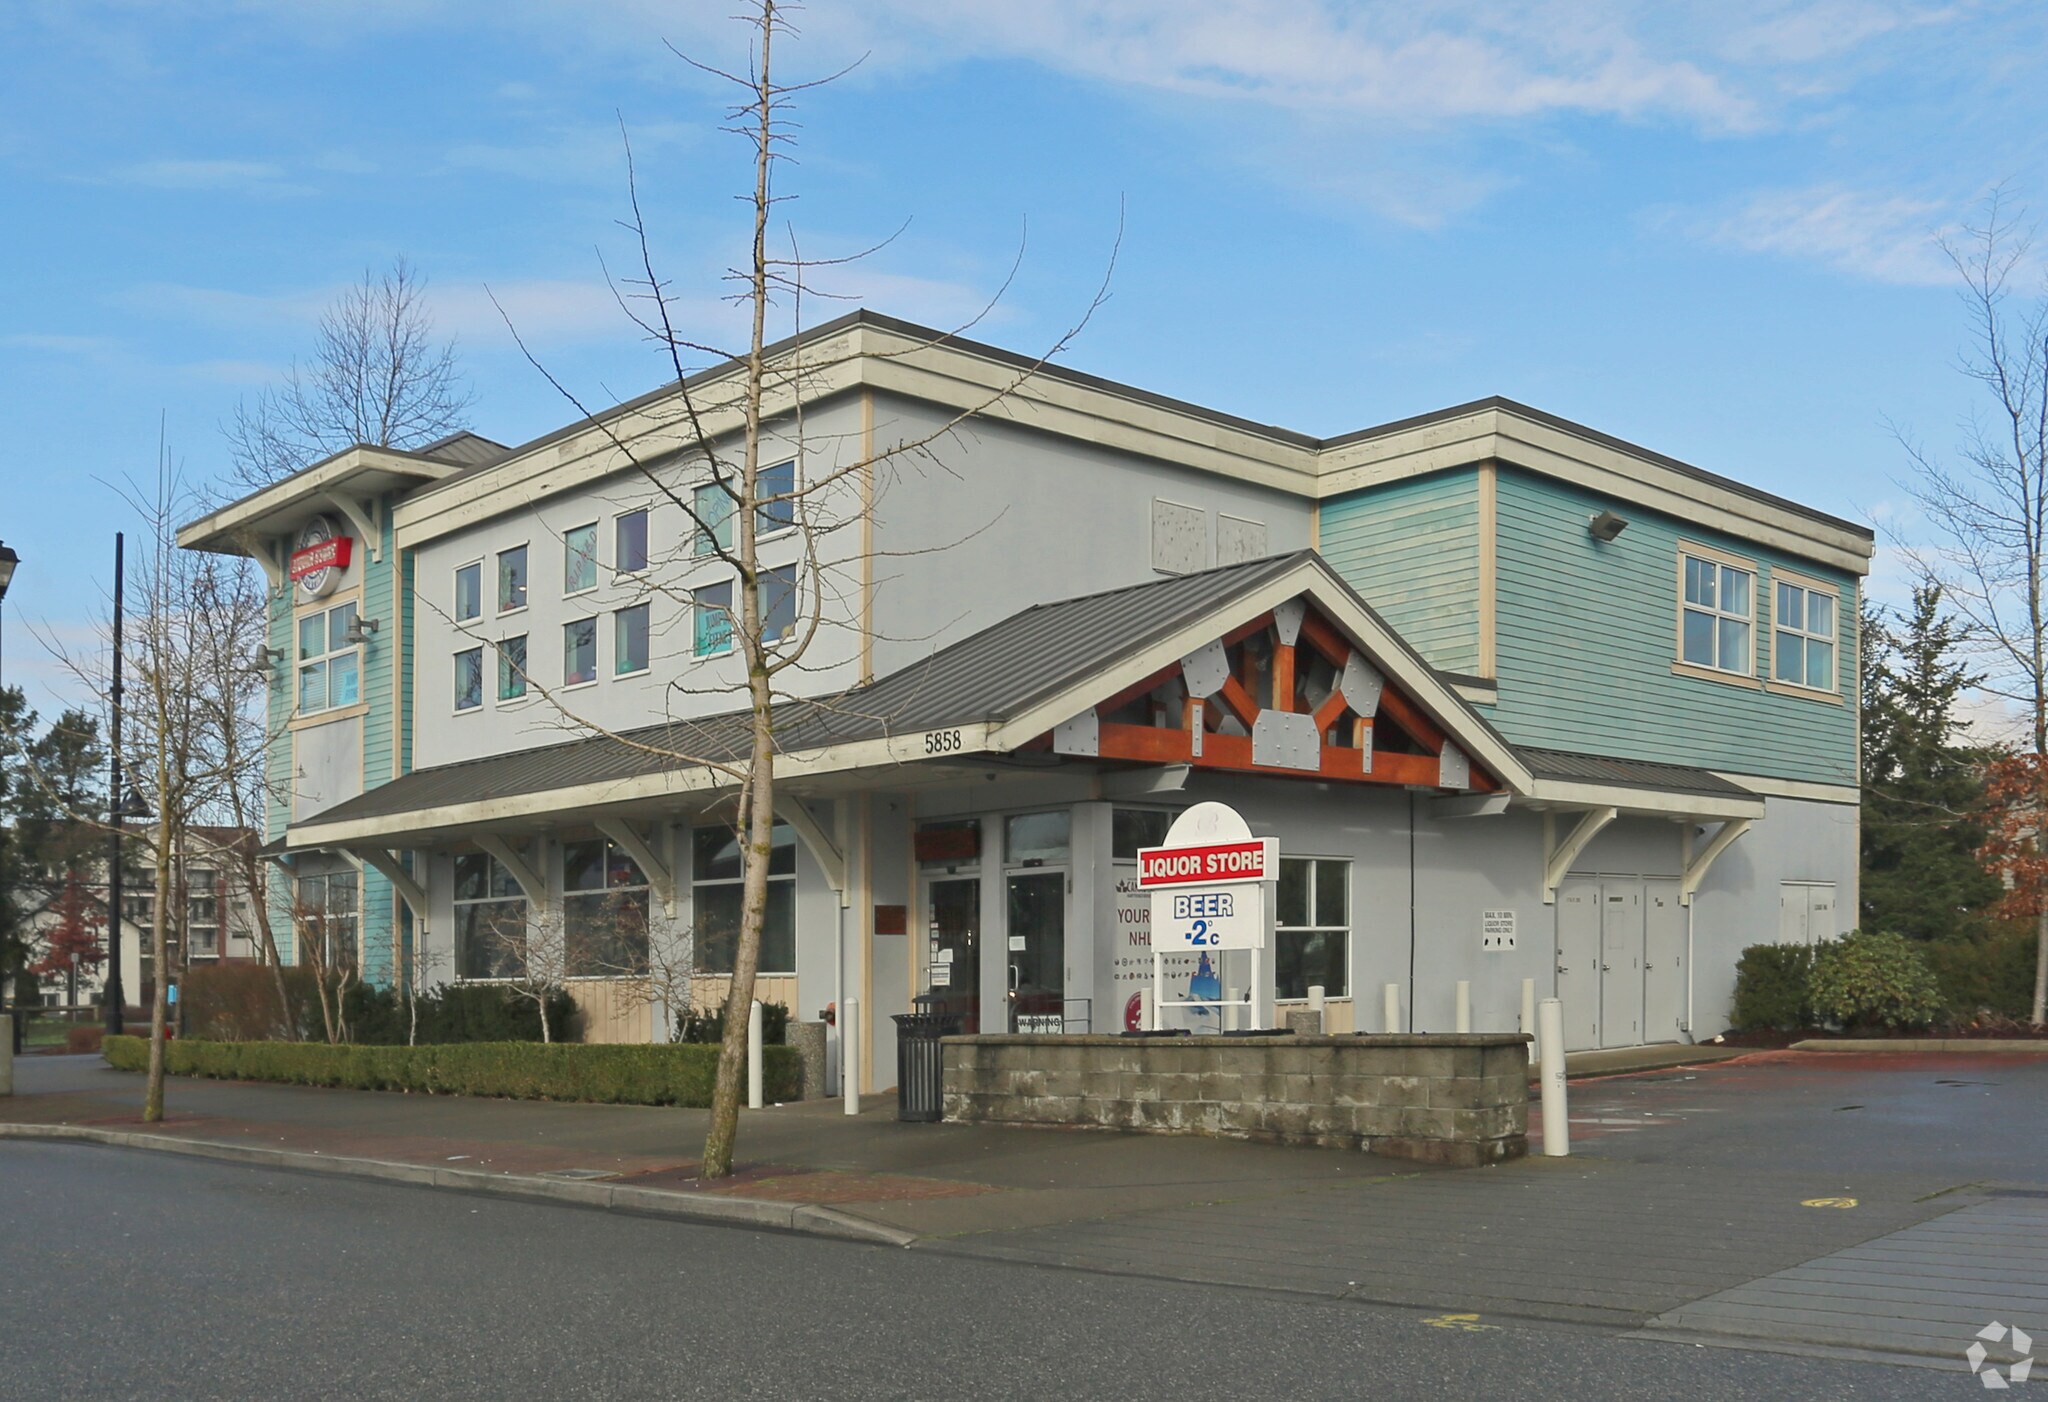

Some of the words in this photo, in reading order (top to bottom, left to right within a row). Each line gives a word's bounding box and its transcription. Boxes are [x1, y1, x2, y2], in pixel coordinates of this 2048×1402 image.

[925, 729, 962, 754] 5858
[1140, 855, 1202, 879] LIQUOR
[1206, 849, 1264, 874] STORE
[1117, 908, 1150, 924] YOUR
[1174, 893, 1234, 919] BEER
[1018, 1017, 1061, 1027] WARNING
